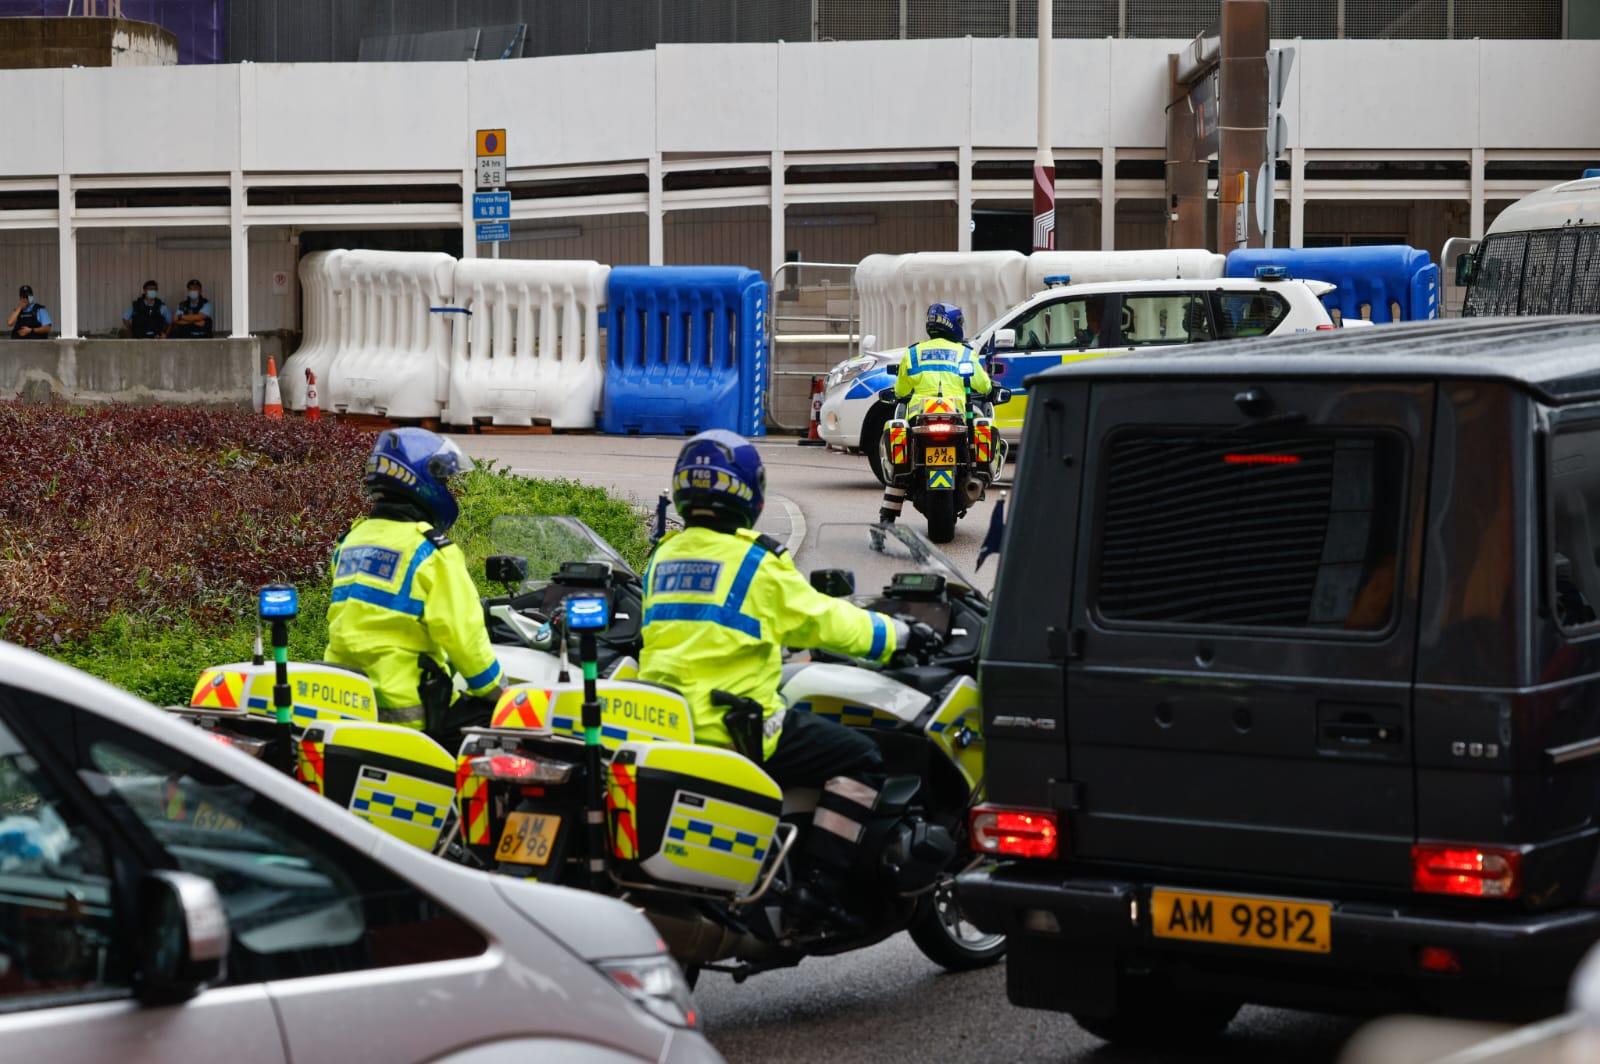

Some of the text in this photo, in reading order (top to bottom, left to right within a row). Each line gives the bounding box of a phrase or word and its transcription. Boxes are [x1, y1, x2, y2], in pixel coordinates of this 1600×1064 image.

[482, 171, 500, 184] 全日
[927, 455, 954, 464] 8746
[312, 683, 359, 708] POLICE
[612, 698, 665, 727] POLICE
[500, 834, 548, 857] 8796
[1168, 897, 1317, 944] AM 9812
